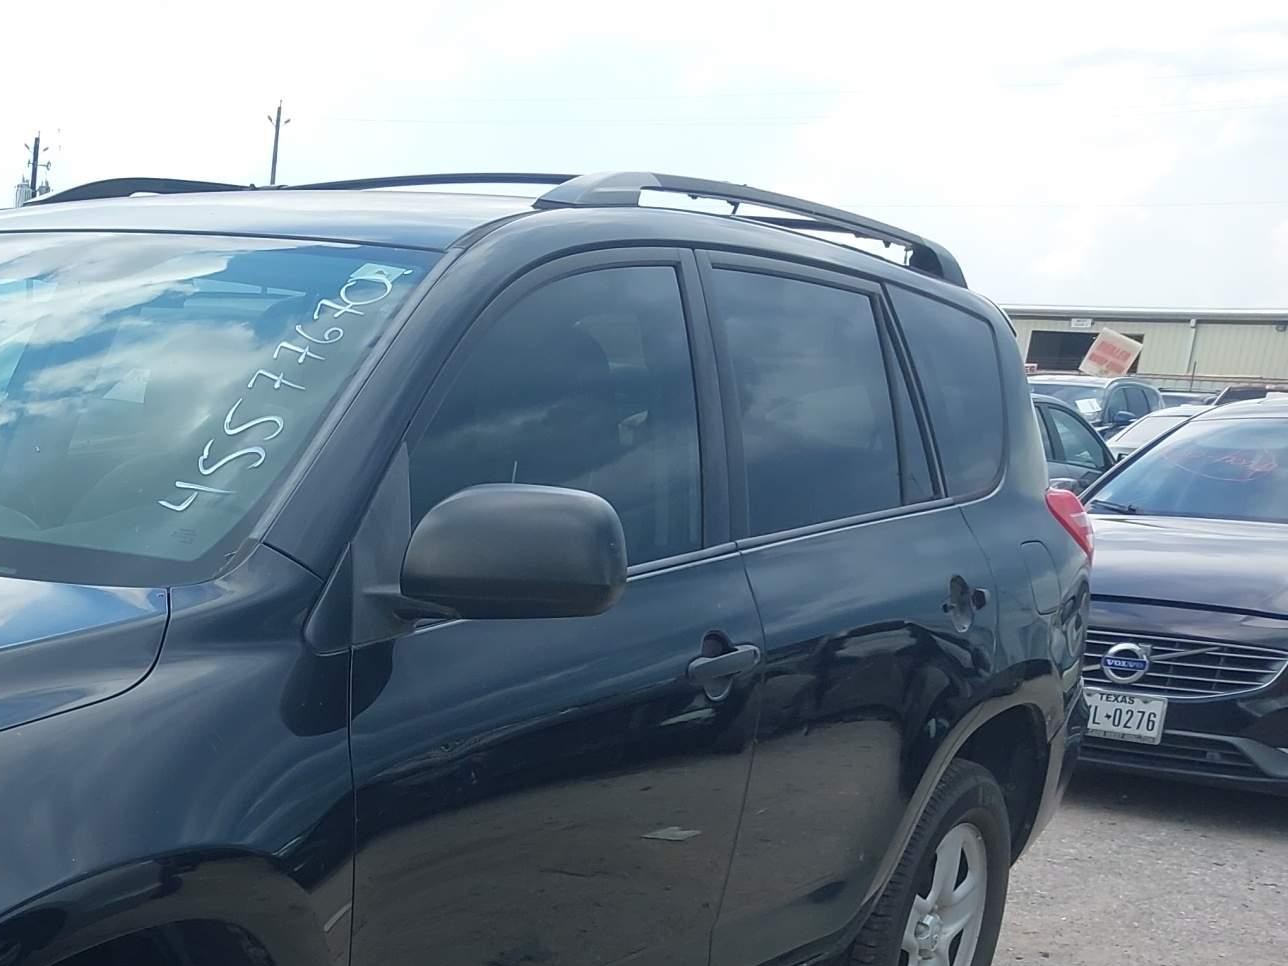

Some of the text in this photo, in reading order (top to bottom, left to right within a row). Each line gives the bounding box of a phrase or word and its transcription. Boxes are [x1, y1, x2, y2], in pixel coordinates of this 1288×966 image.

[158, 273, 394, 512] 45577670
[1106, 658, 1145, 669] VOLVO
[1099, 692, 1136, 705] TEXAS
